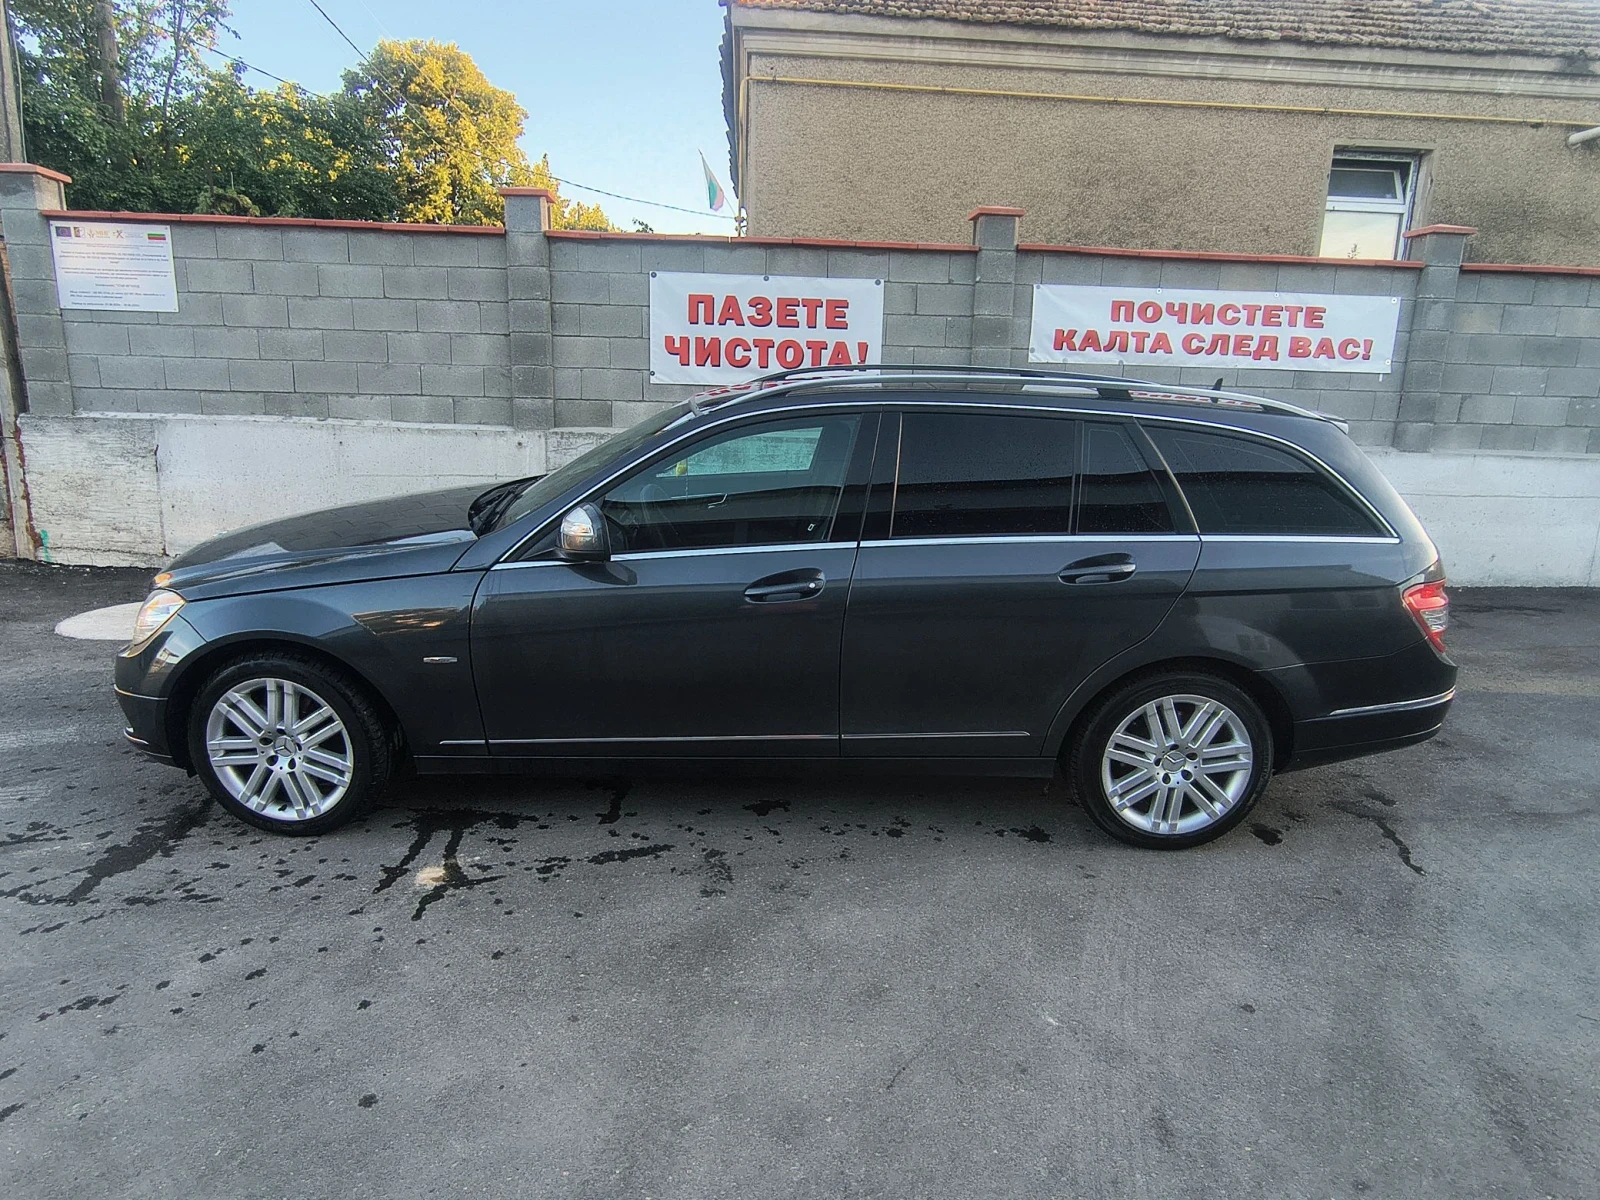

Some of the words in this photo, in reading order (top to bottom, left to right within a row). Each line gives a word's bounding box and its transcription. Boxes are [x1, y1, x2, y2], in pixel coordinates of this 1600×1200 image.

[687, 293, 849, 329] ПАЗЕТЕ
[1111, 300, 1326, 328] ПОЧИСТЕТЕ
[664, 335, 869, 371] ЧИСТОТА!
[1053, 329, 1173, 354] КАЛТА
[1181, 333, 1280, 361] СЛЕД
[1288, 337, 1373, 360] ВАС!
